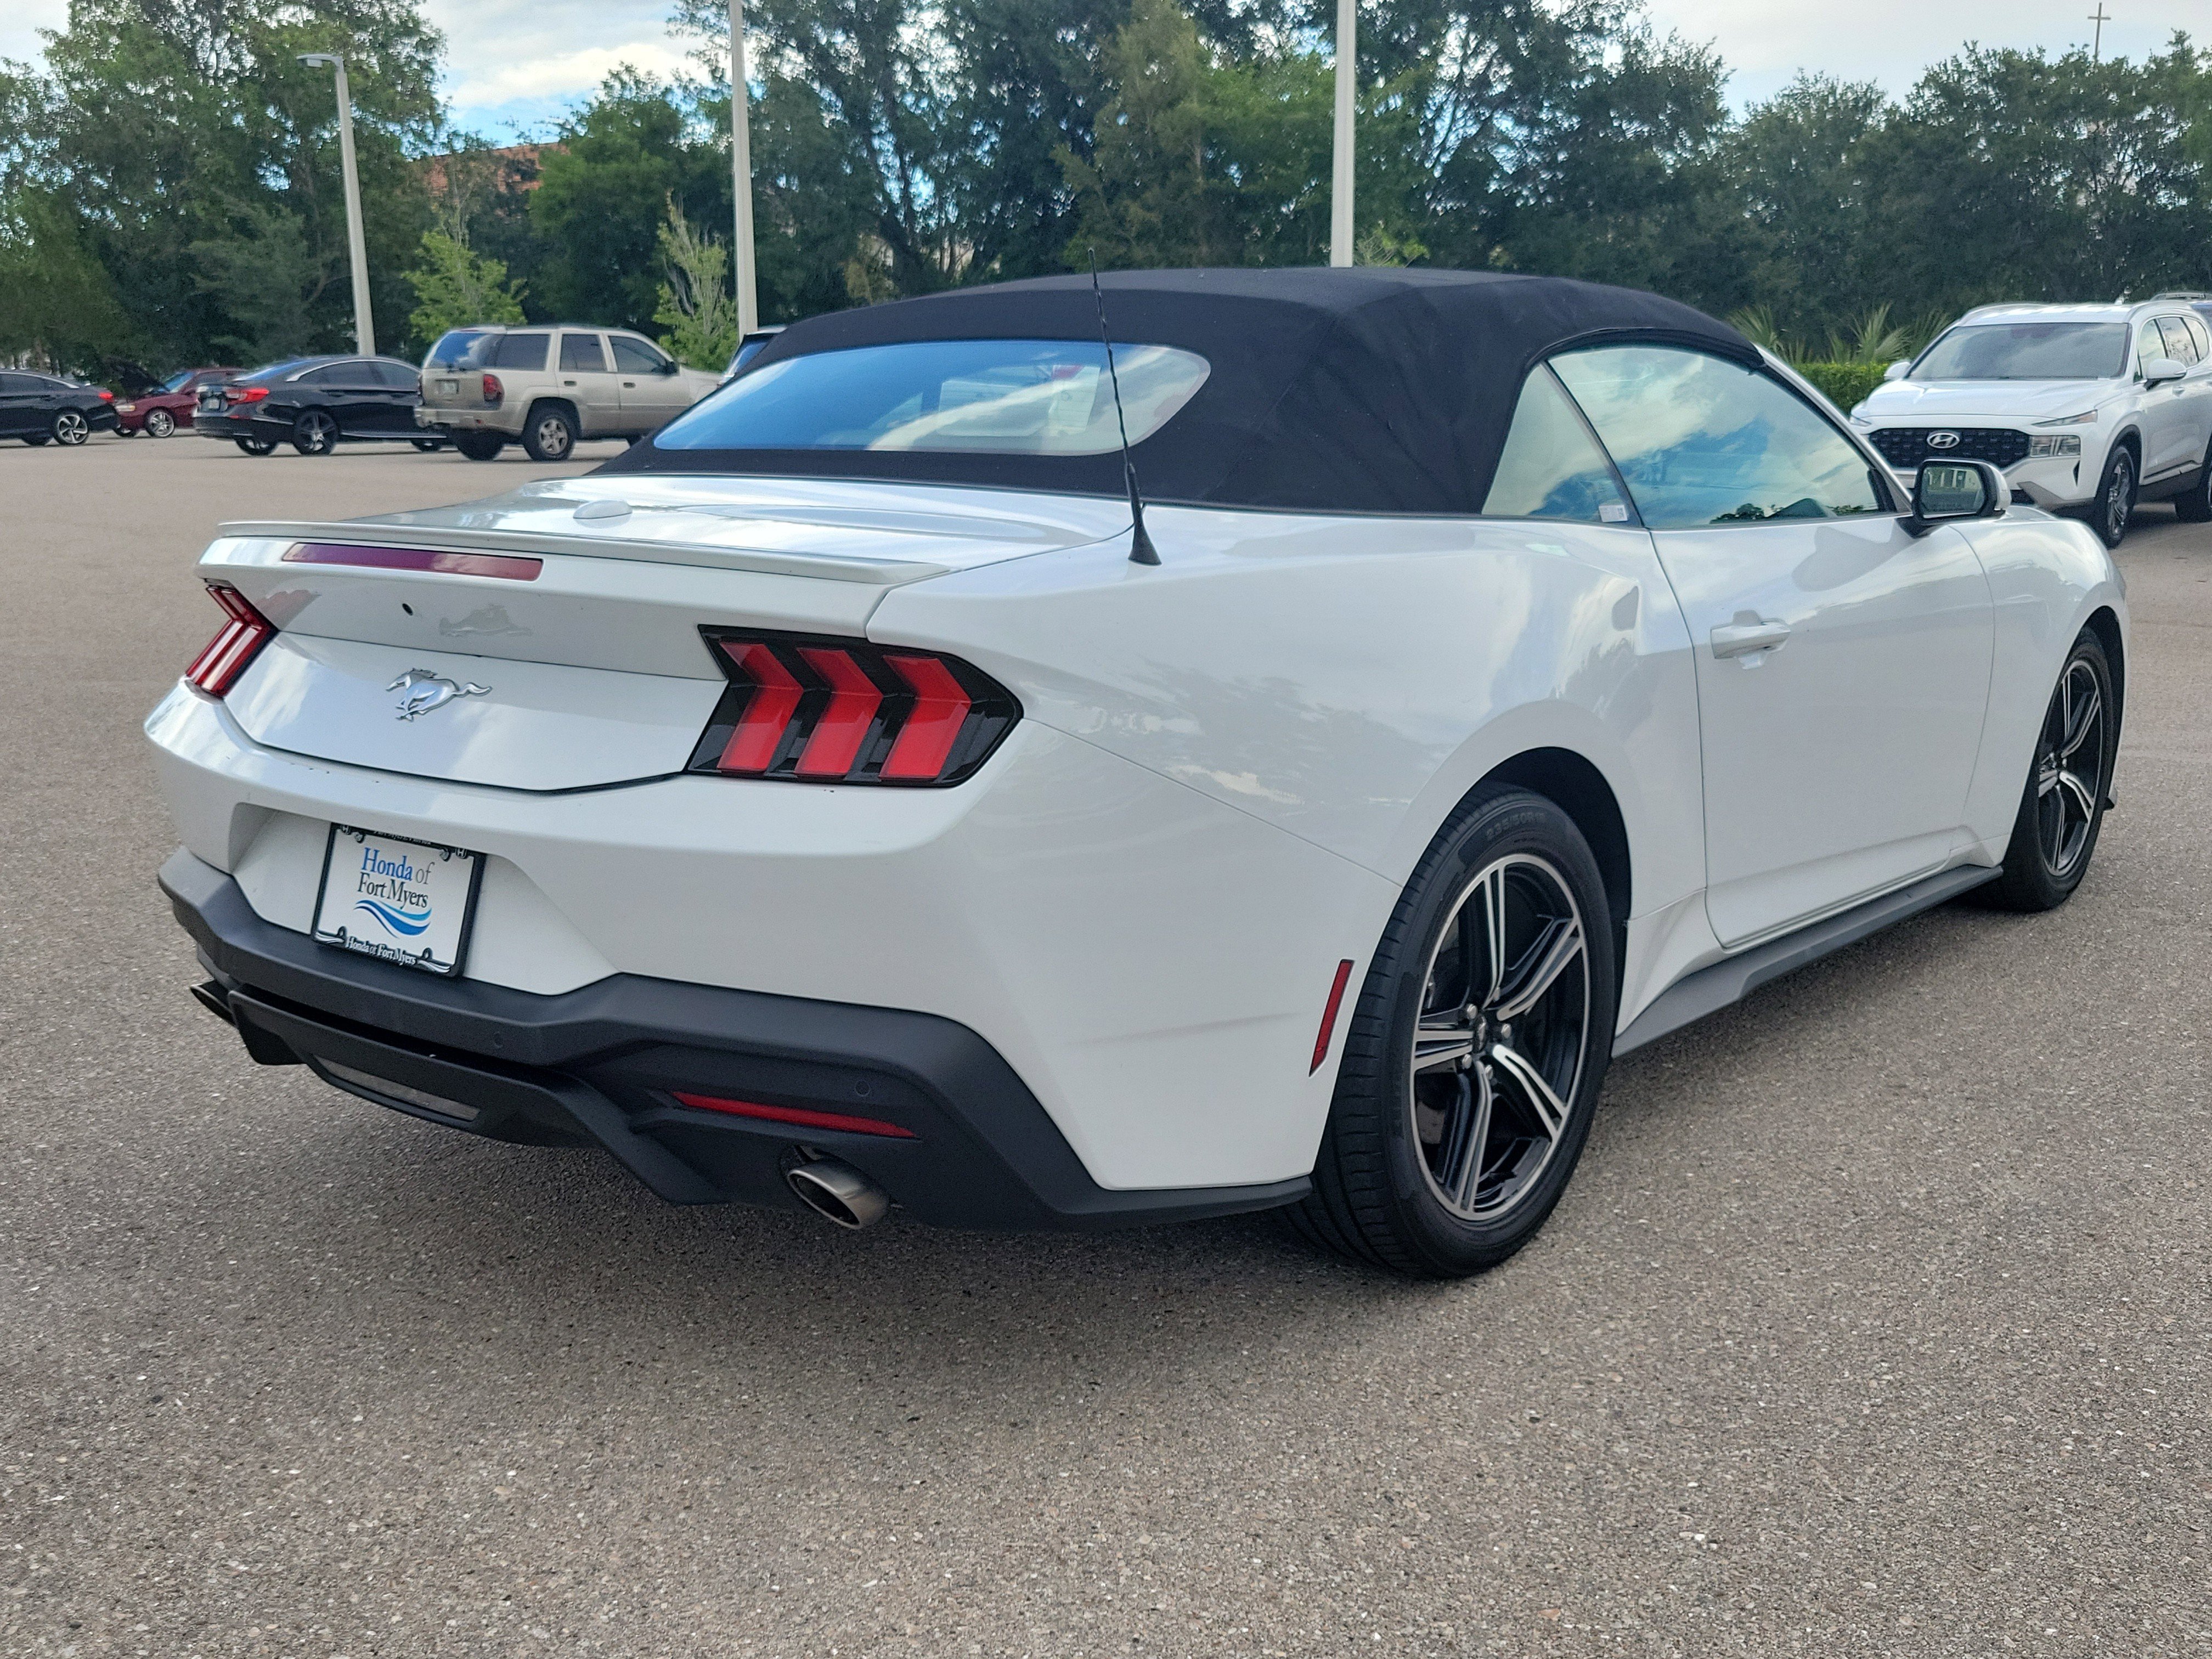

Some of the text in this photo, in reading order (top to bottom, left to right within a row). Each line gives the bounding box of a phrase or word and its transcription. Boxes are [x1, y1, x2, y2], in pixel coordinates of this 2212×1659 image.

[362, 847, 435, 884] Honda of
[358, 872, 428, 910] Fort Myers
[345, 936, 369, 952] Honda
[377, 944, 393, 959] Fort
[393, 949, 416, 966] Myers
